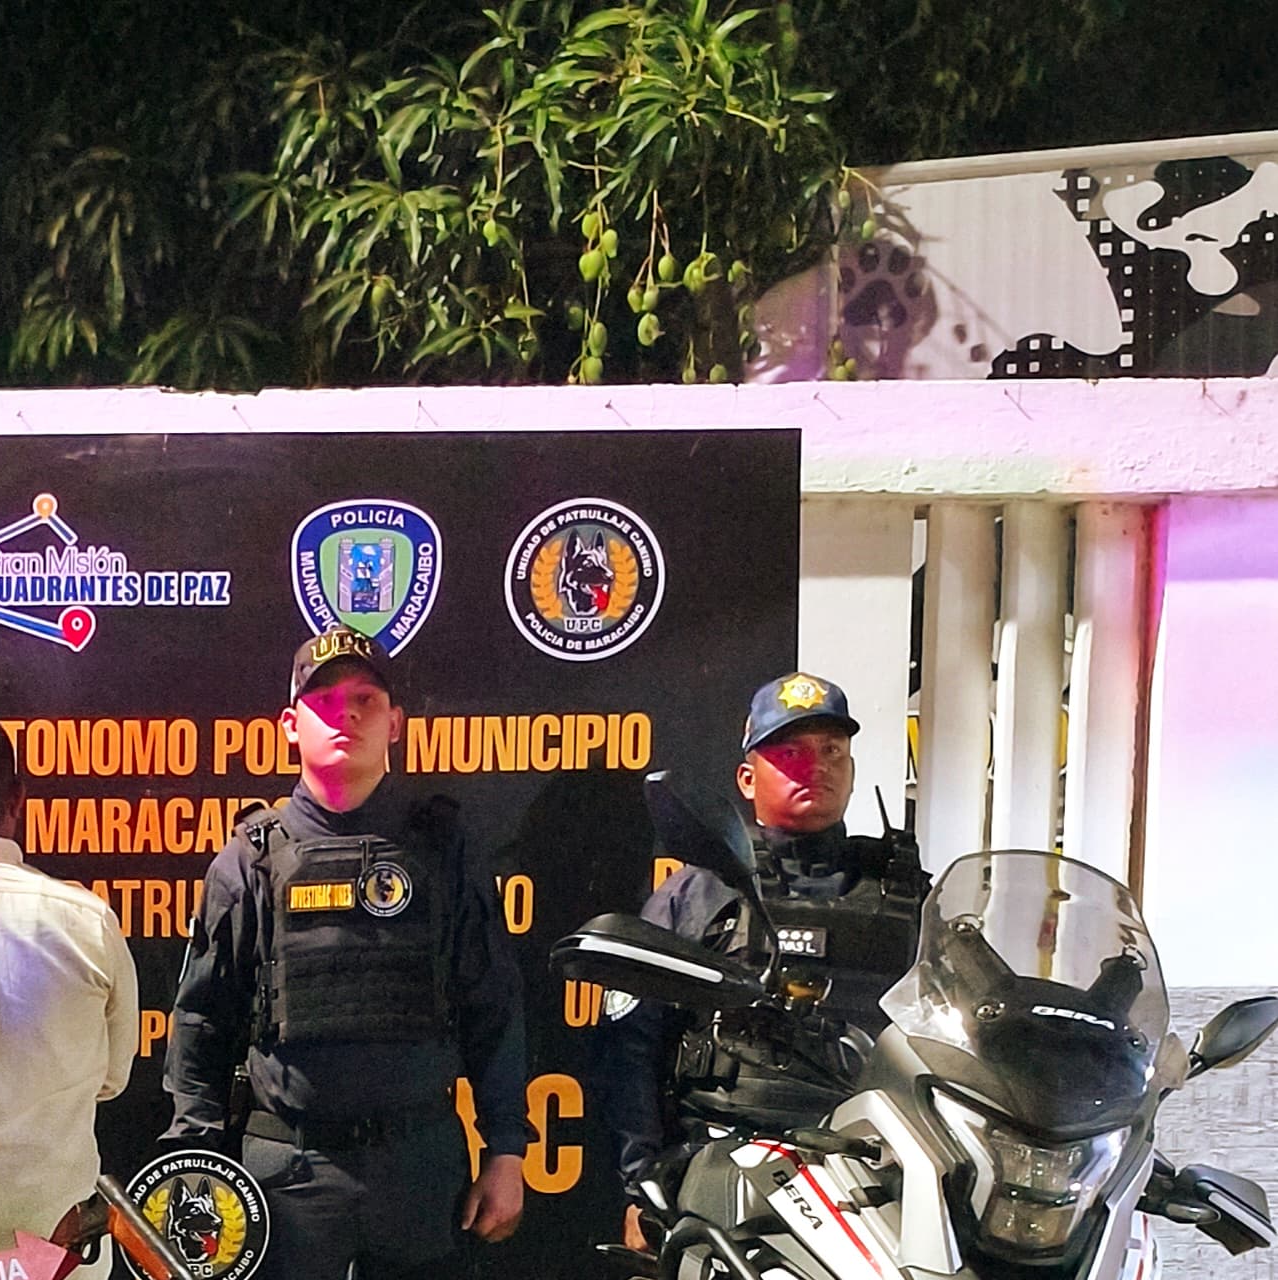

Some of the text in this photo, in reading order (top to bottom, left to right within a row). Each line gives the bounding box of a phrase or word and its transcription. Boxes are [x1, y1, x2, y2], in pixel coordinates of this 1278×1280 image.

[330, 509, 405, 529] POLICÍA
[47, 547, 125, 574] Misión
[516, 509, 653, 581] UNIDAD DE PATRULLAJE CANINO
[145, 574, 178, 602] DE
[182, 573, 230, 602] PAZ
[390, 542, 434, 641] MARACAIBO
[526, 603, 645, 651] POLICIA DE MARACAIBO
[565, 618, 602, 632] UPC
[406, 713, 652, 773] MUNICIPIO
[26, 797, 288, 855] MARACAI
[1032, 1005, 1115, 1031] BERA
[146, 1158, 261, 1223] DE PATRULLAJE CANINO
[772, 1169, 824, 1230] BERA
[189, 1263, 214, 1279] PC
